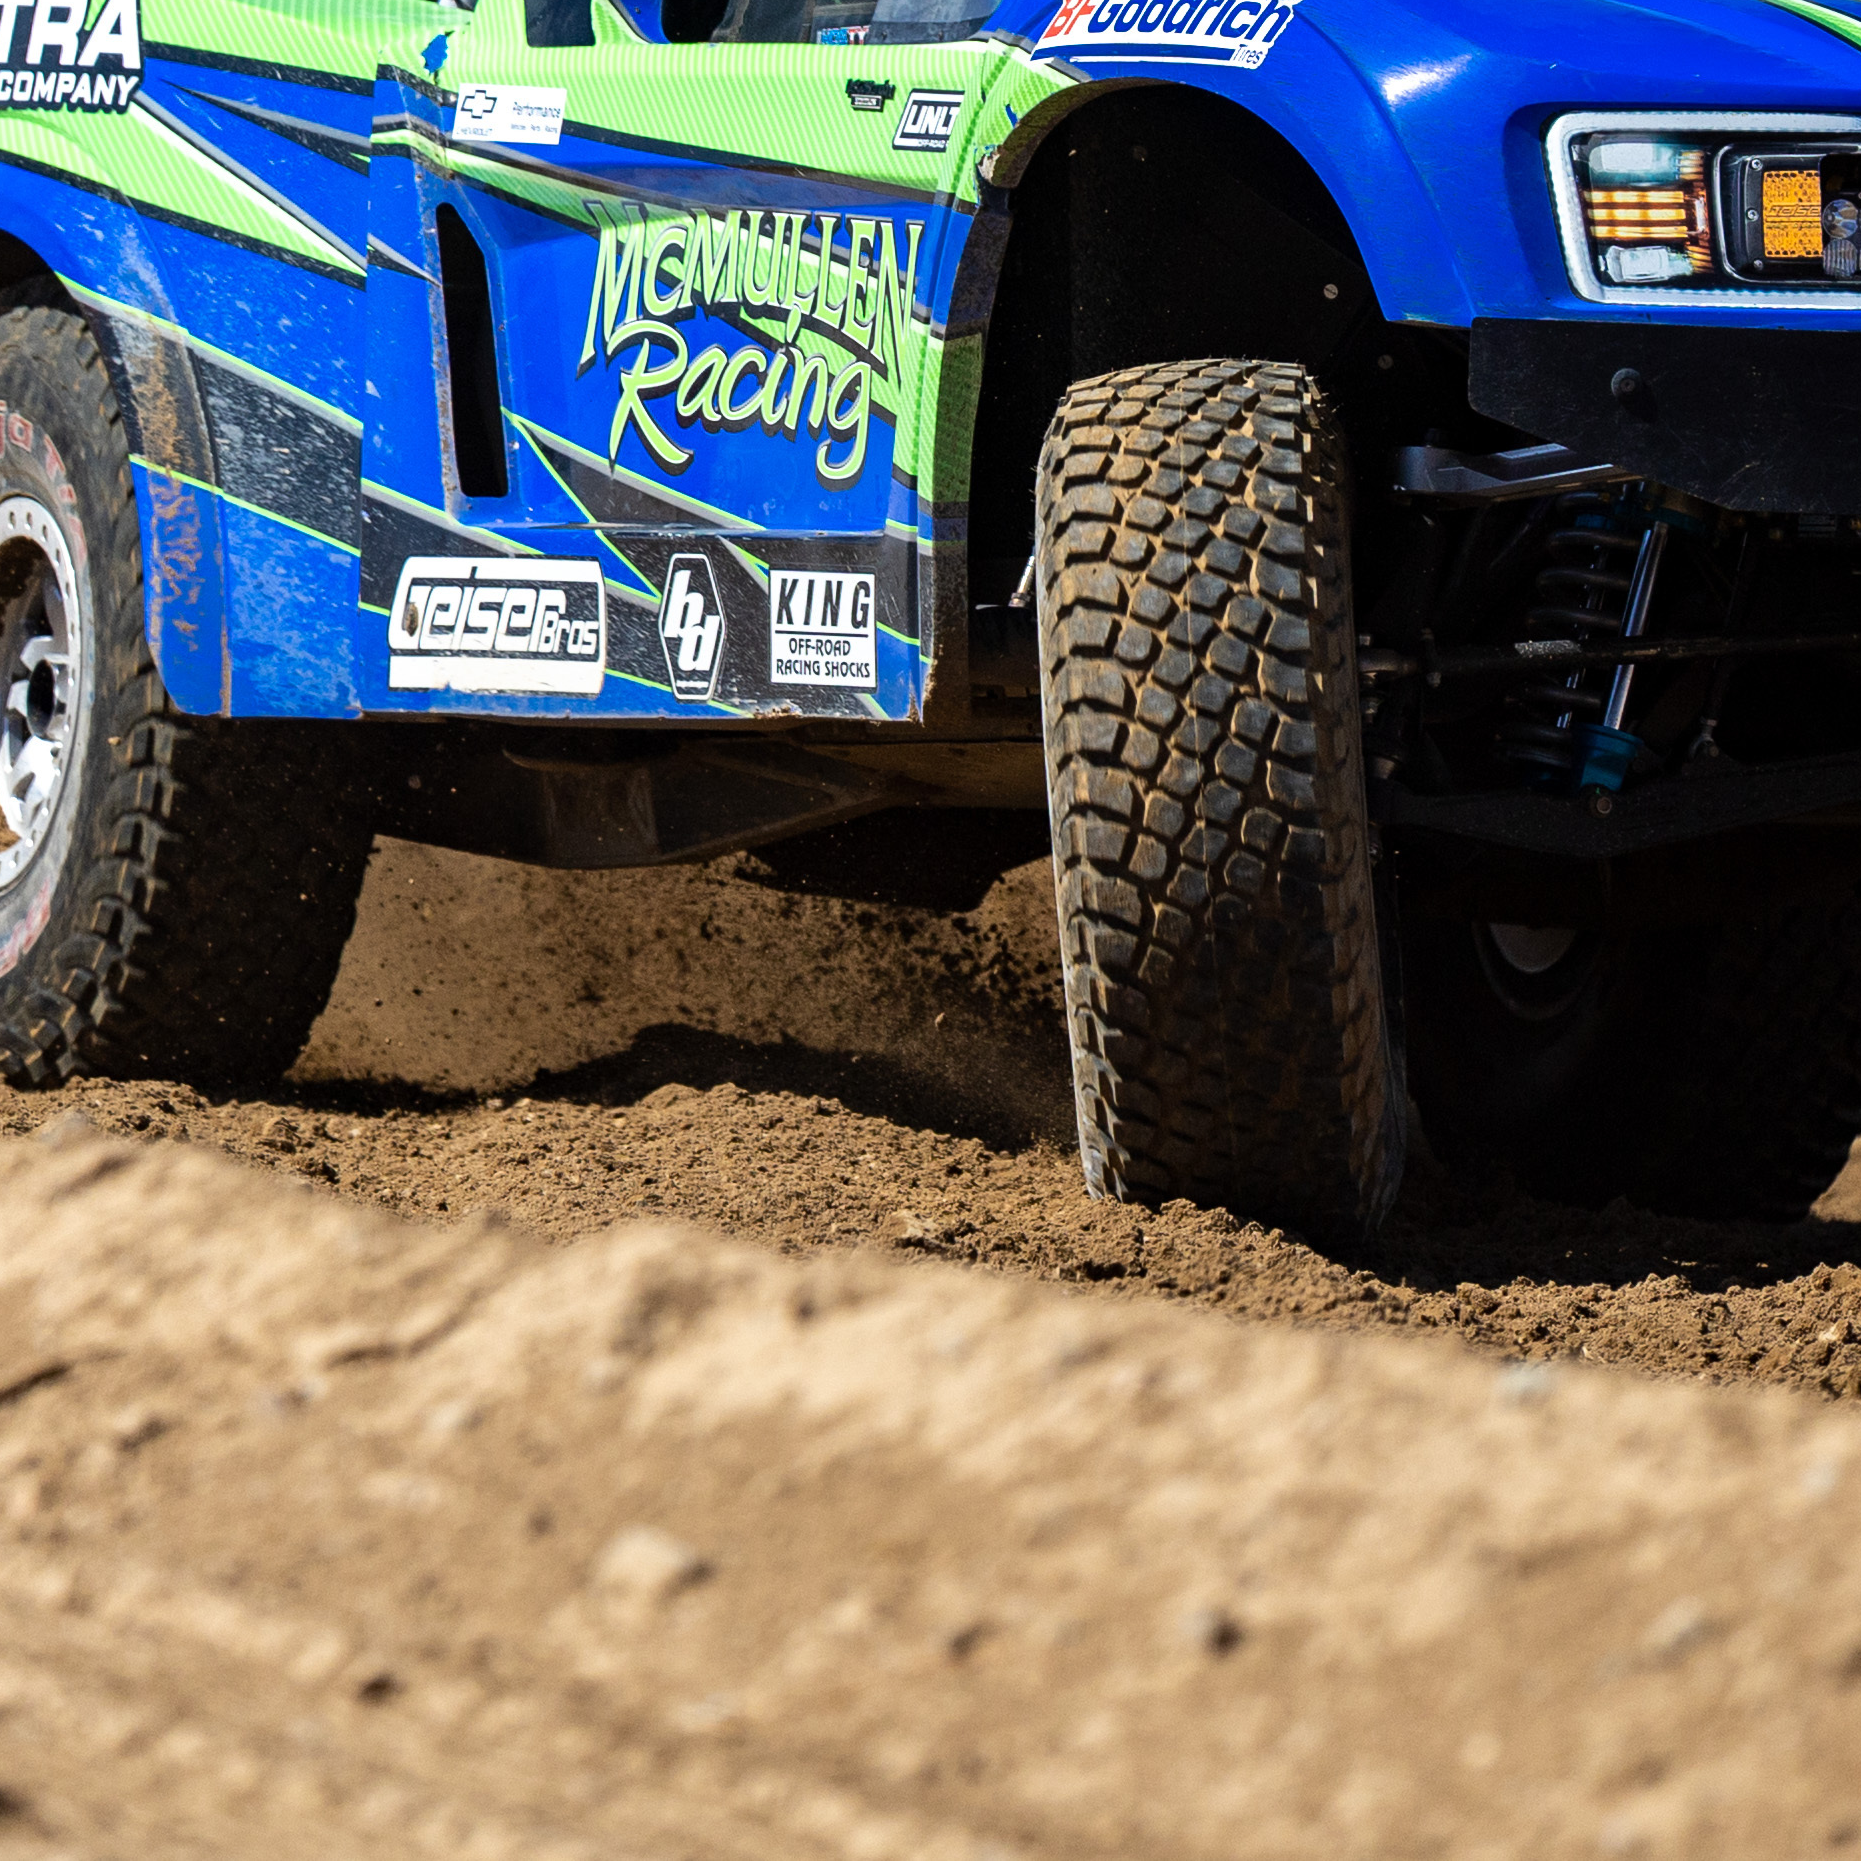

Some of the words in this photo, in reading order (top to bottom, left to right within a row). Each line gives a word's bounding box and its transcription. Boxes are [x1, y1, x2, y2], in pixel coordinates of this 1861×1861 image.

[1234, 44, 1265, 64] Tires
[578, 202, 925, 393] McMULLEN
[606, 304, 871, 472] Racing
[776, 578, 871, 629] KING
[789, 638, 851, 656] OFF-ROAD
[776, 658, 820, 676] RACING
[825, 661, 870, 678] SHOCKS
